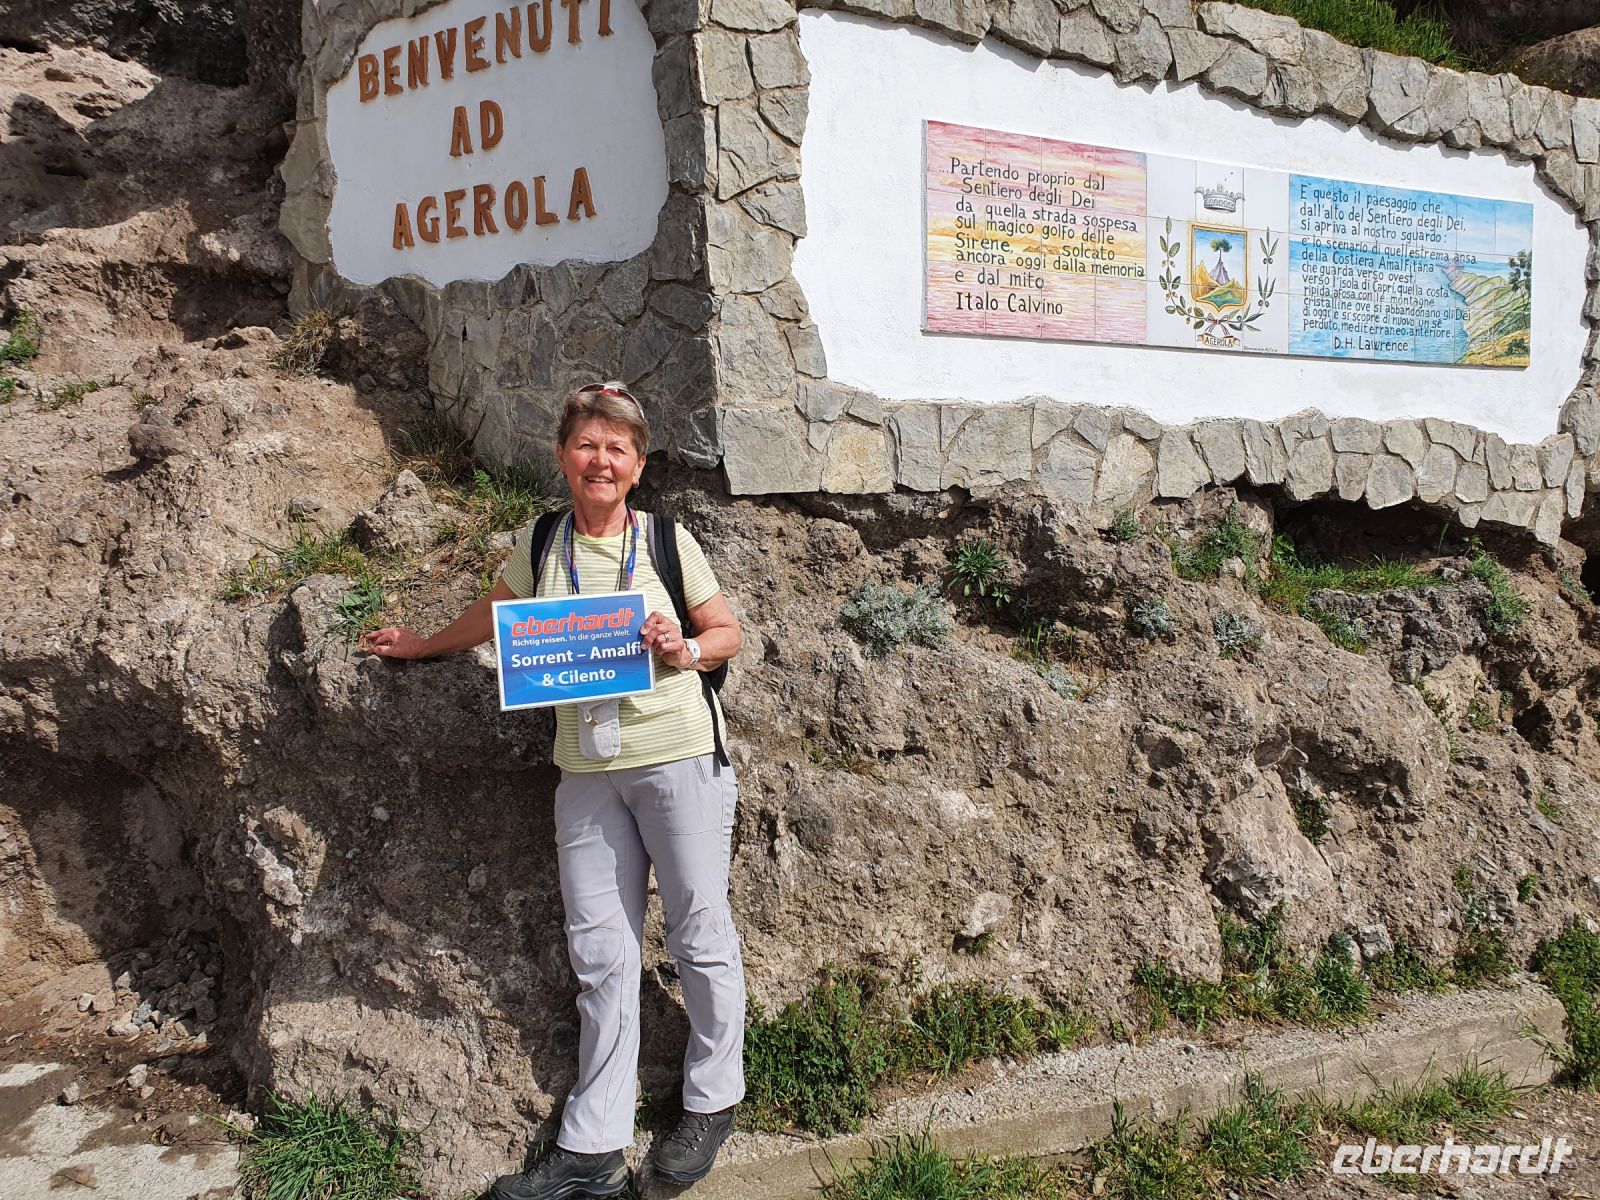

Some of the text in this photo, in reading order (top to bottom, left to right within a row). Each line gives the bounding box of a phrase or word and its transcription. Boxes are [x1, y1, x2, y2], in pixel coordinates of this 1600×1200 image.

[358, 0, 614, 102] BENVENUTI
[450, 100, 503, 157] AD
[961, 177, 1095, 208] Sentiero degli Dei
[1028, 172, 1075, 190] proprio
[1083, 174, 1105, 191] dal
[392, 166, 597, 250] AGEROLA
[1313, 188, 1348, 203] questo
[1354, 191, 1360, 204] il
[1367, 194, 1416, 213] paesaggio
[956, 196, 1138, 233] da quella strada sospesa
[1300, 202, 1466, 231] dall'alto del Sentiero degli Dei,
[955, 214, 976, 230] sul
[986, 219, 1034, 236] magico
[1081, 227, 1115, 244] delle
[1315, 221, 1346, 235] apriva
[1352, 223, 1360, 236] al
[1364, 225, 1396, 239] nostro
[955, 232, 1115, 261] Sirene, solcato
[1302, 247, 1327, 262] della
[1333, 252, 1373, 268] Costiera
[1313, 234, 1321, 248] lo
[1327, 239, 1368, 253] scenario
[1372, 240, 1380, 255] di
[1454, 252, 1476, 264] ansa
[956, 250, 1145, 277] ancora oggi dalla memoria
[1302, 262, 1317, 273] che
[1320, 264, 1353, 277] guarda
[1357, 268, 1383, 281] verso
[955, 267, 1045, 289] e dal mito
[1302, 274, 1329, 285] verso
[1333, 276, 1358, 290] l'isola
[1362, 280, 1369, 291] di
[1397, 283, 1423, 297] quella
[1427, 285, 1449, 298] costa
[956, 292, 1063, 315] Italo Calvino
[1304, 297, 1471, 321] cristalline ove si abbandonano gli Dei
[1377, 292, 1385, 303] le
[1390, 295, 1434, 309] montagne
[1303, 306, 1310, 317] di
[1313, 308, 1330, 320] oggi
[1334, 310, 1339, 320] e
[1342, 311, 1351, 321] si
[1352, 312, 1380, 324] scopre
[1383, 314, 1390, 325] di
[1393, 315, 1415, 328] nuovo
[1419, 319, 1429, 329] un
[1204, 336, 1232, 347] AGEROLA
[1359, 336, 1408, 352] Lawrence
[511, 608, 635, 637] eberhardt
[512, 637, 540, 647] Richtig
[542, 635, 567, 645] reisen.
[578, 633, 589, 641] die
[590, 632, 612, 641] ganze
[614, 629, 631, 637] Welt.
[511, 651, 574, 668] Sorrent
[590, 641, 642, 660] Amalfi
[542, 668, 616, 687] & Cilento
